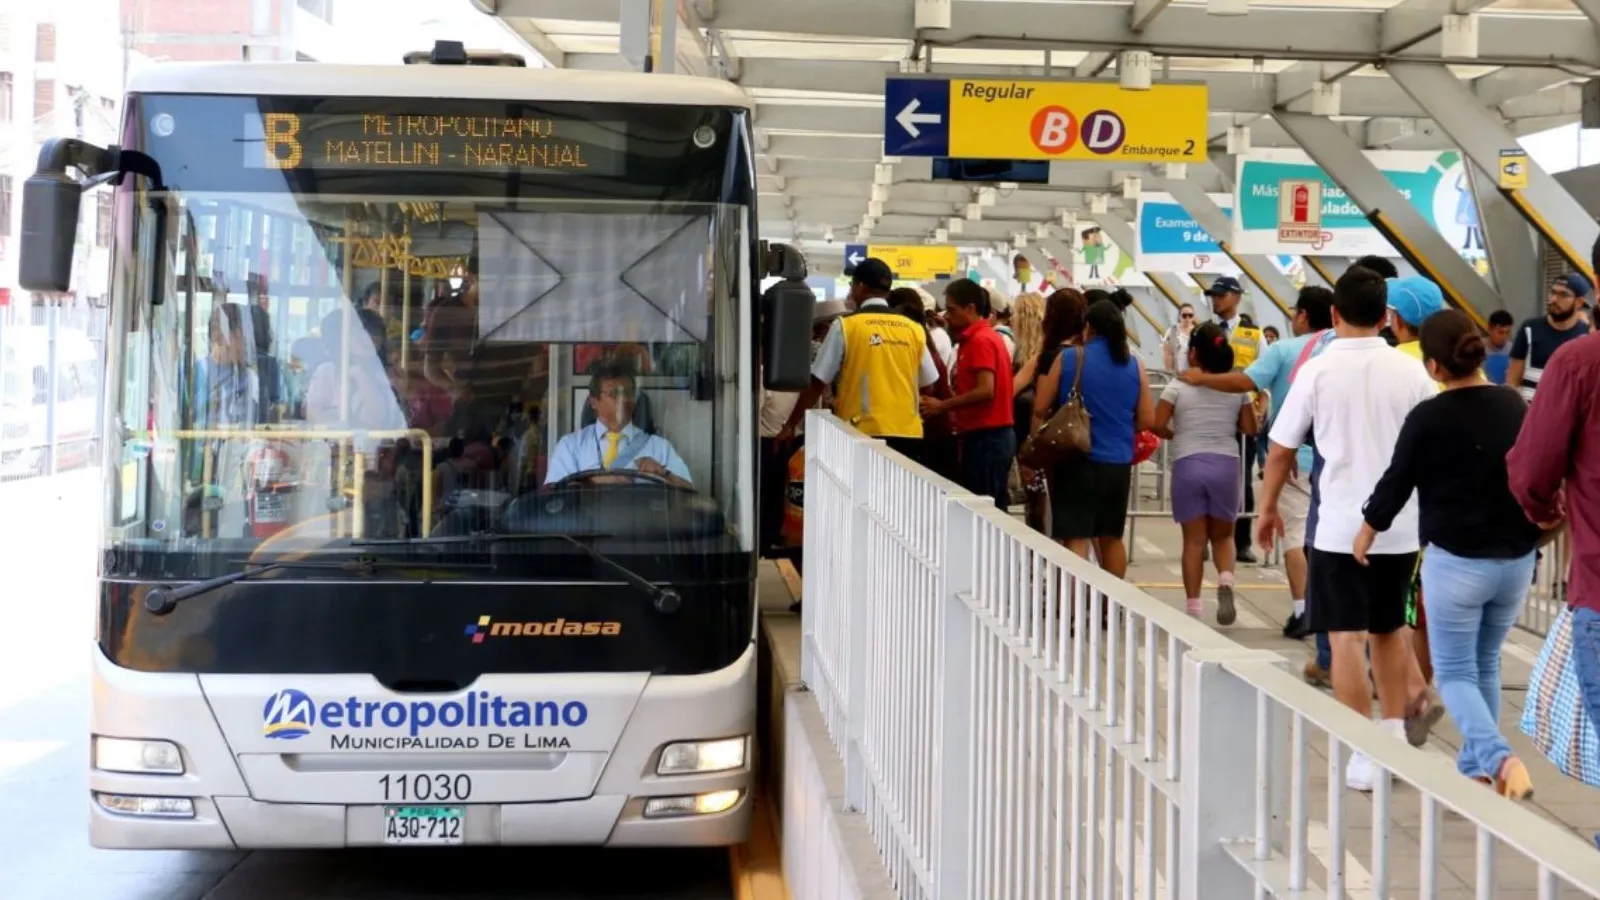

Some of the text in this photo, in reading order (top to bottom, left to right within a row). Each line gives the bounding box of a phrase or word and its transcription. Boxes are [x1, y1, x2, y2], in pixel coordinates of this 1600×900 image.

[962, 82, 1035, 102] Regular
[363, 114, 553, 138] METROPOLITANO
[1040, 111, 1122, 149] B D
[265, 112, 302, 170] B
[1122, 139, 1196, 156] Embarque 2
[326, 141, 440, 166] MATELLINI
[464, 143, 588, 167] NARANJAL
[1155, 217, 1199, 228] Examen
[1183, 231, 1192, 242] 9
[1281, 229, 1318, 238] EXTINTOR
[490, 618, 621, 636] modasa
[263, 688, 588, 740] Metropolitano
[330, 734, 479, 749] MUNICIPALIDAD
[524, 733, 571, 749] LIMA
[378, 774, 472, 801] 11030
[387, 817, 460, 838] A3Q-712
